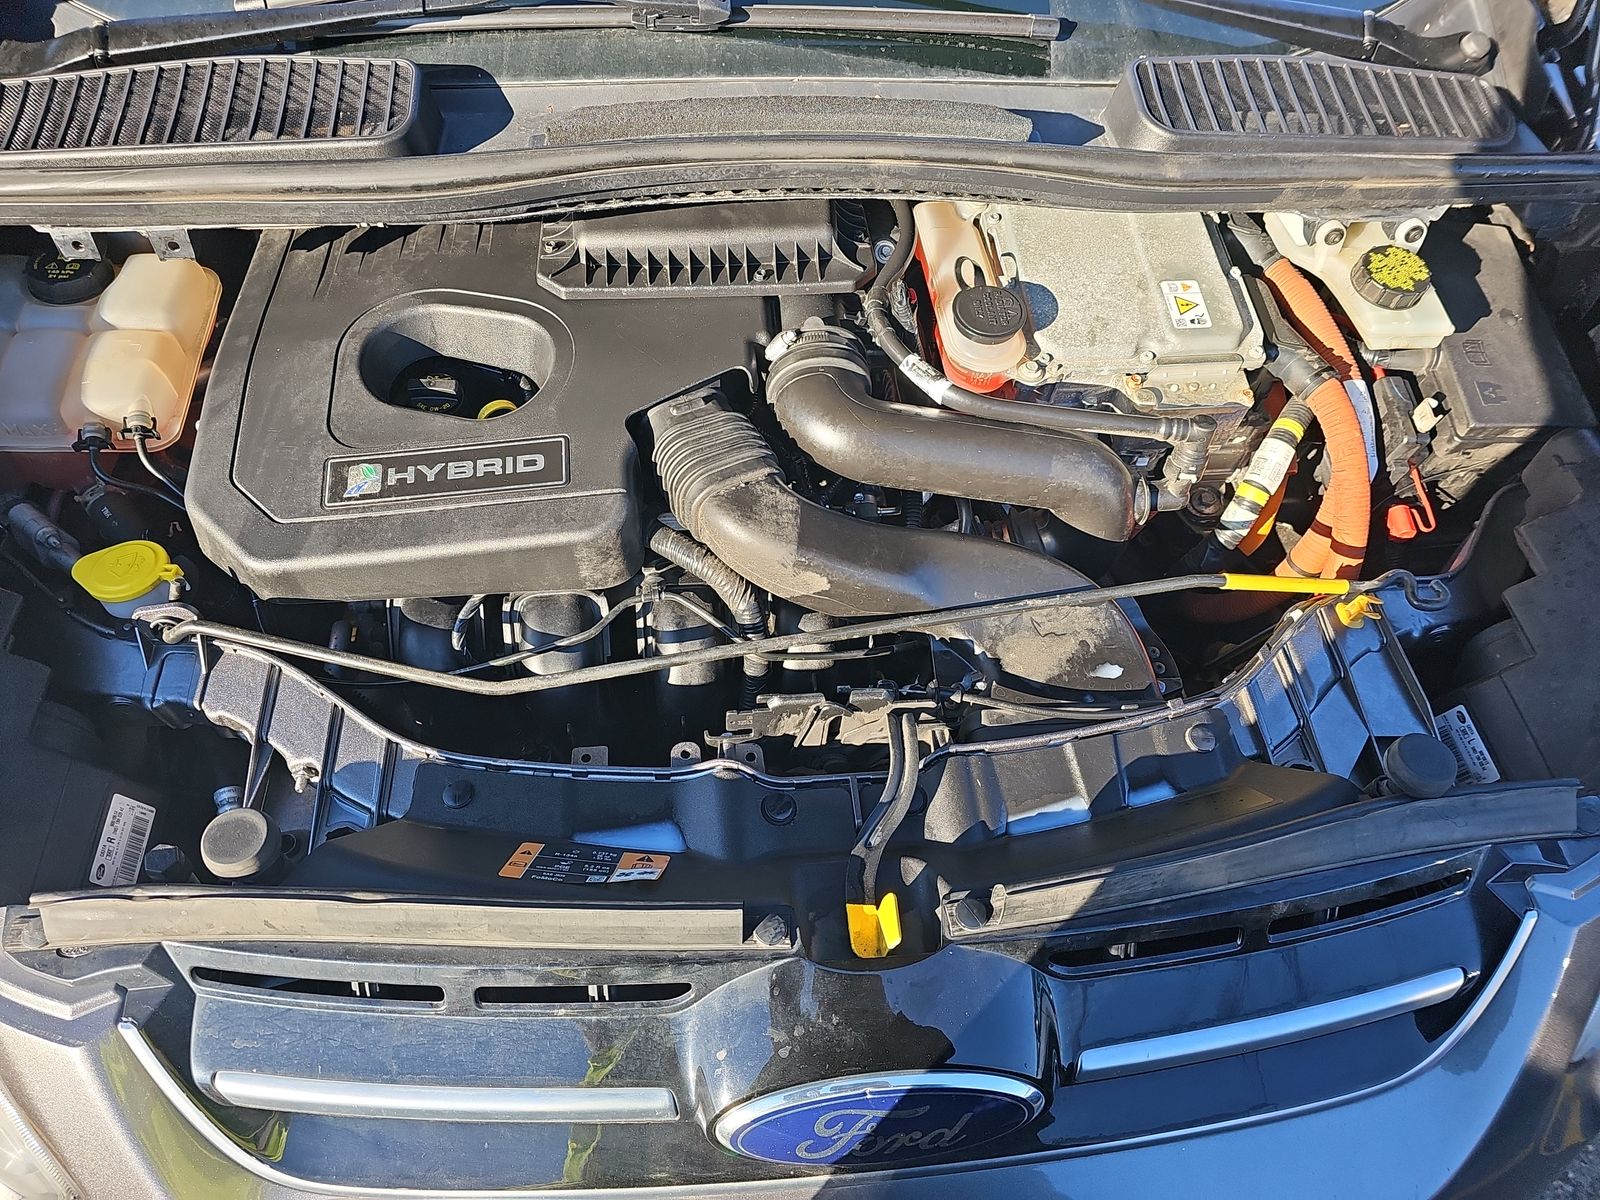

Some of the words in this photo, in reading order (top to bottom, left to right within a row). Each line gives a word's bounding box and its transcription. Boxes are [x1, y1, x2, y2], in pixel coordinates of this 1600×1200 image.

[982, 291, 998, 326] COOLANT
[387, 454, 545, 486] HYBRID
[106, 837, 116, 845] R
[795, 1105, 974, 1159] Ford
